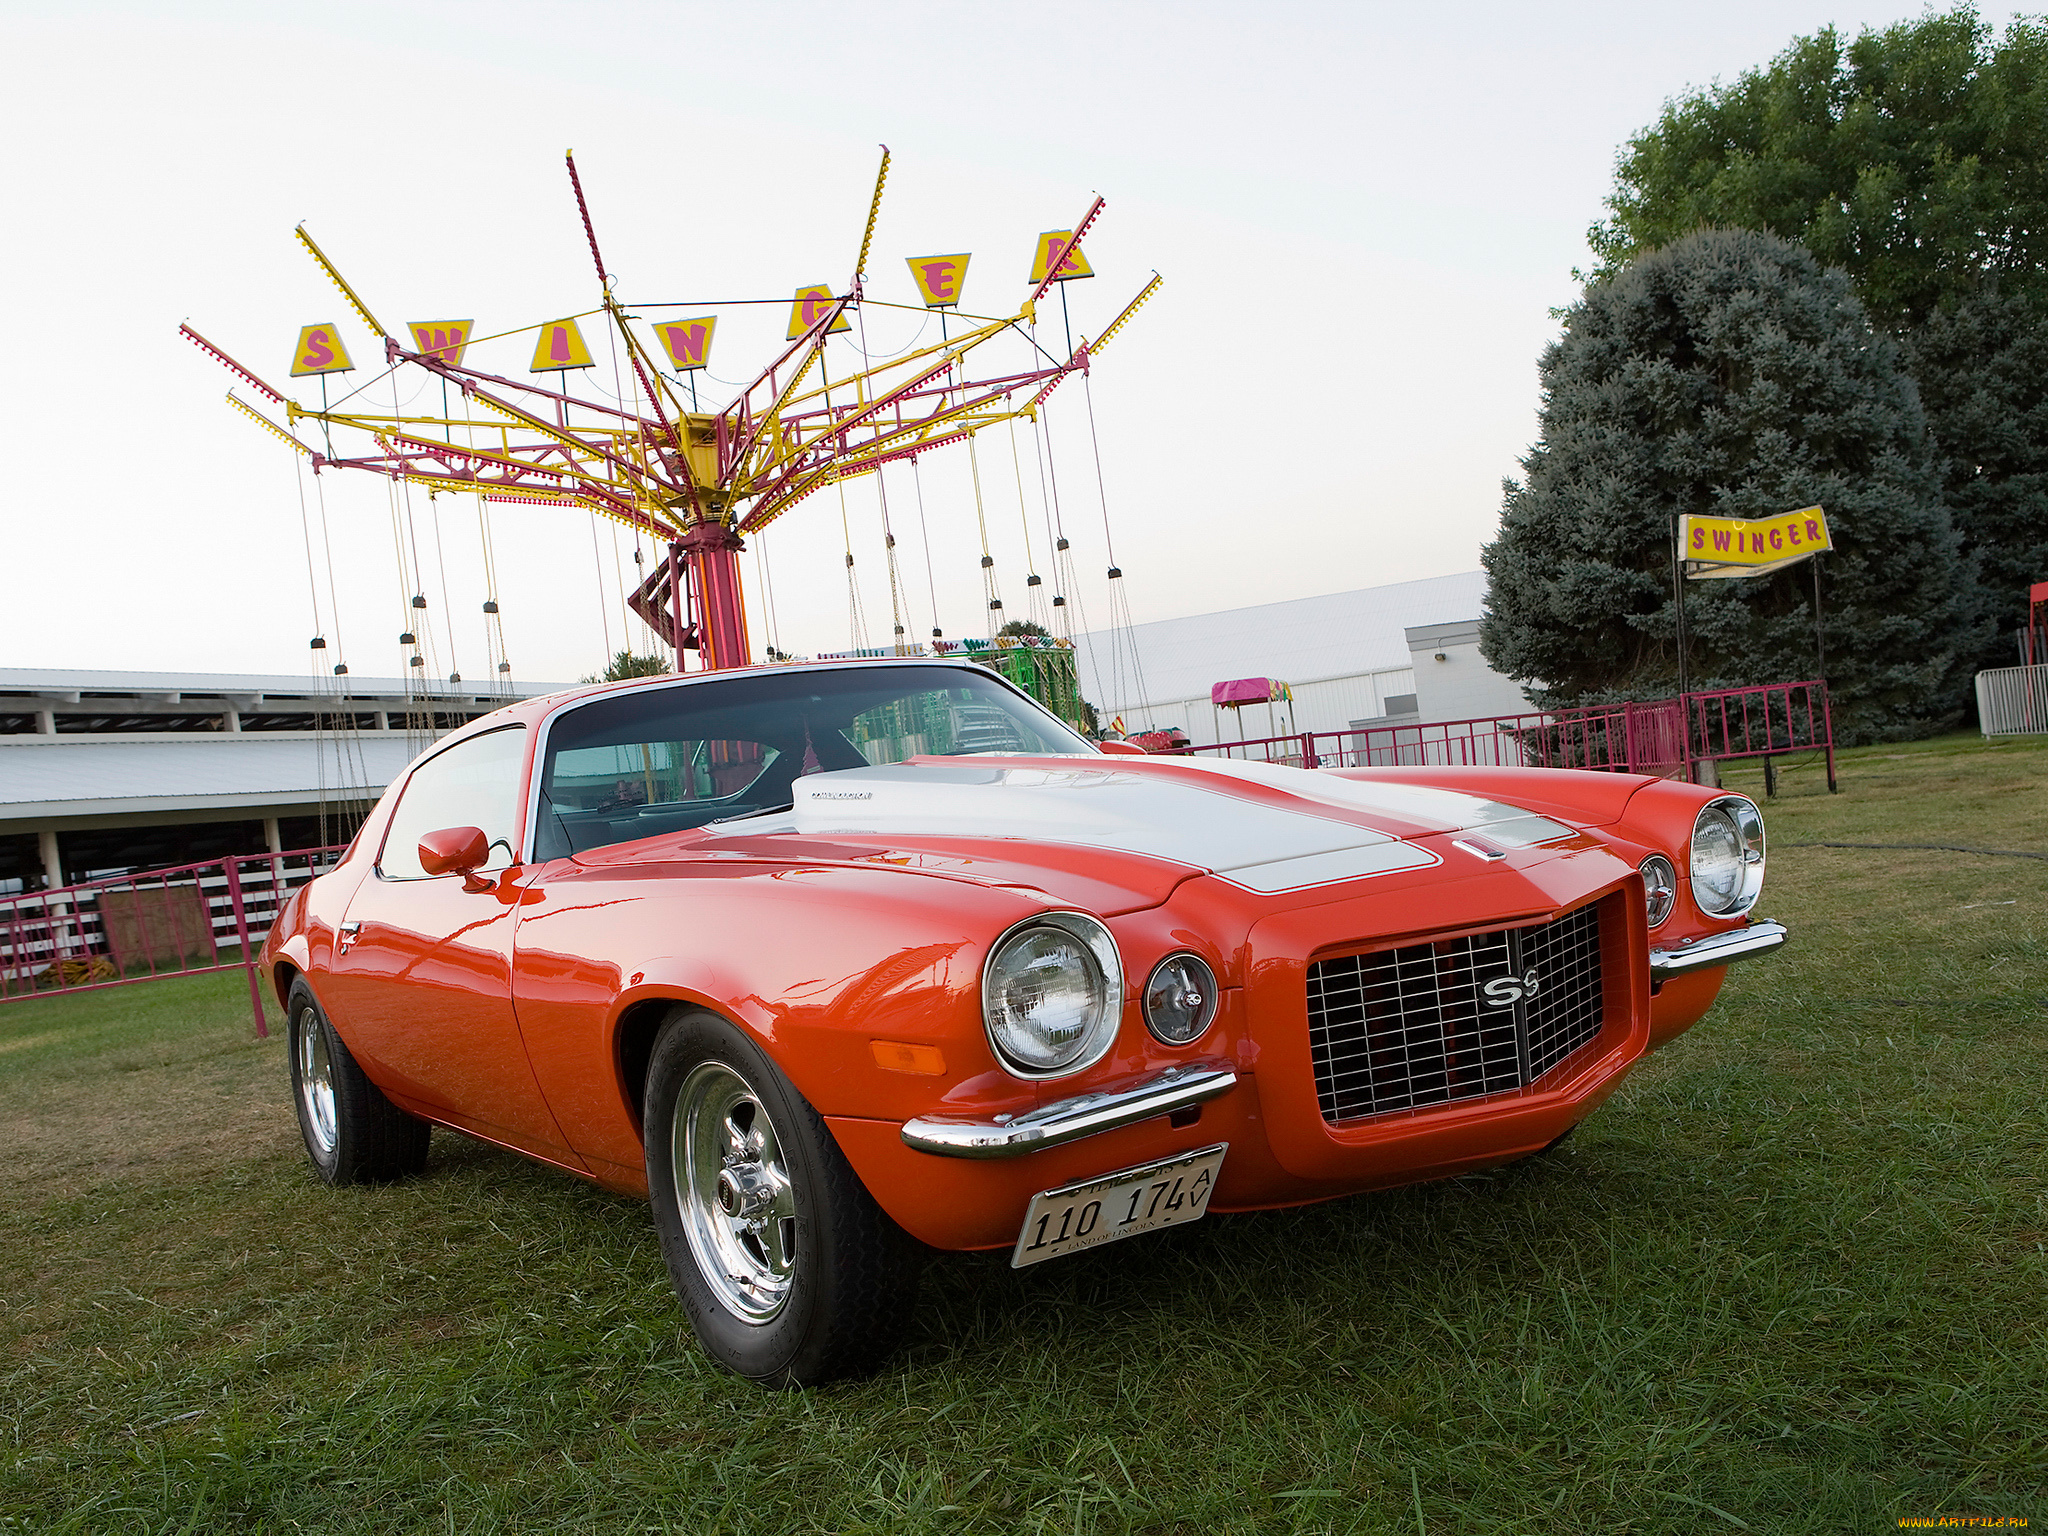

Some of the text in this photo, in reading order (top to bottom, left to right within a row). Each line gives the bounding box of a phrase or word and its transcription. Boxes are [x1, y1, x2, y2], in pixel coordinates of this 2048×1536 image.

[1693, 520, 1821, 554] SWINGER
[1484, 970, 1539, 1006] SS
[1026, 1175, 1184, 1251] 110 174
[1067, 1220, 1157, 1250] LAND OF LINCOLN
